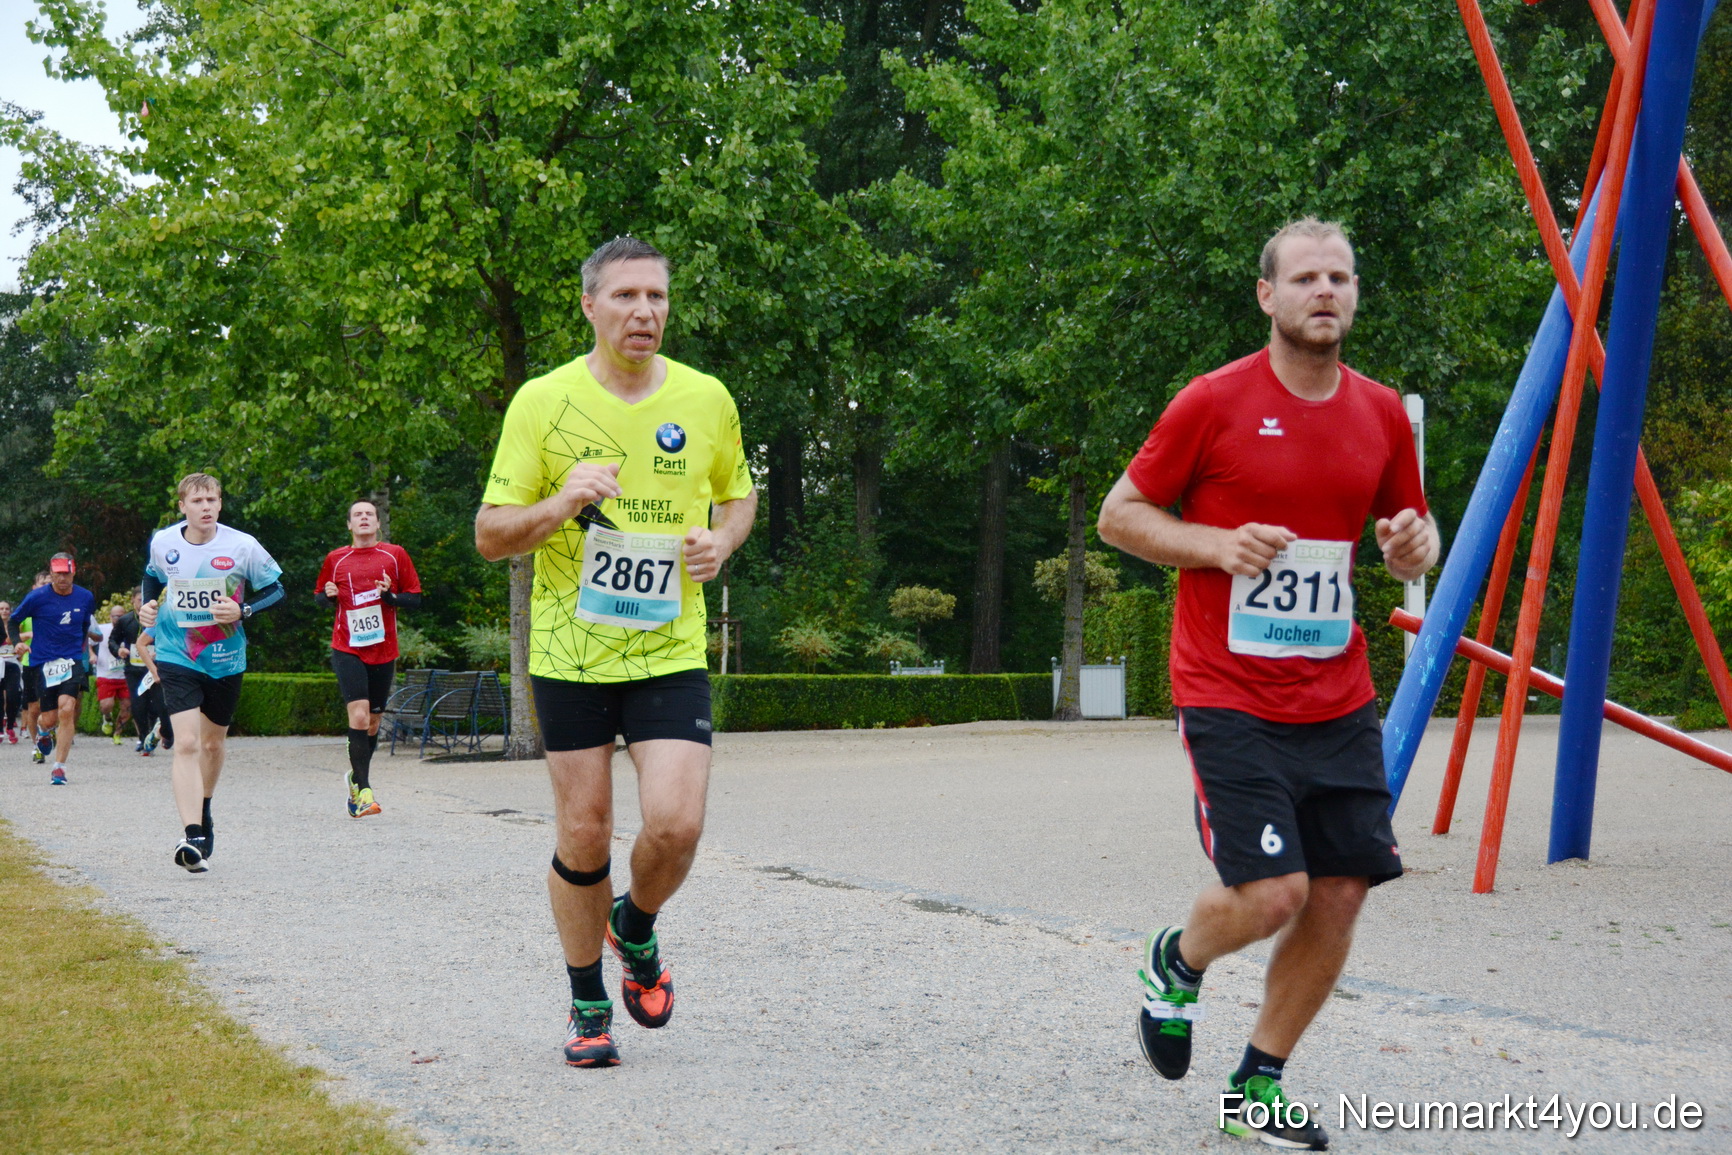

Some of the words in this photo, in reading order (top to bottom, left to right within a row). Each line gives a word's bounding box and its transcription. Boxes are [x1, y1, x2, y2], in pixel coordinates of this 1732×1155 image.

[1258, 427, 1283, 436] erima
[653, 456, 686, 470] Partl
[653, 468, 686, 476] Neumarkt
[616, 498, 639, 510] THE
[642, 499, 672, 511] NEXT
[627, 511, 648, 523] 100
[649, 512, 684, 524] YEARS
[631, 537, 676, 549] BOCK
[1295, 545, 1345, 561] BOCK
[591, 551, 675, 594] 2867
[1245, 569, 1341, 613] 2311
[177, 589, 222, 609] 2569
[615, 600, 640, 616] Ulli
[186, 613, 214, 621] Manuel
[352, 614, 380, 633] 2463
[1264, 623, 1321, 642] Jochen
[212, 643, 226, 652] 17.
[1260, 823, 1283, 855] 6
